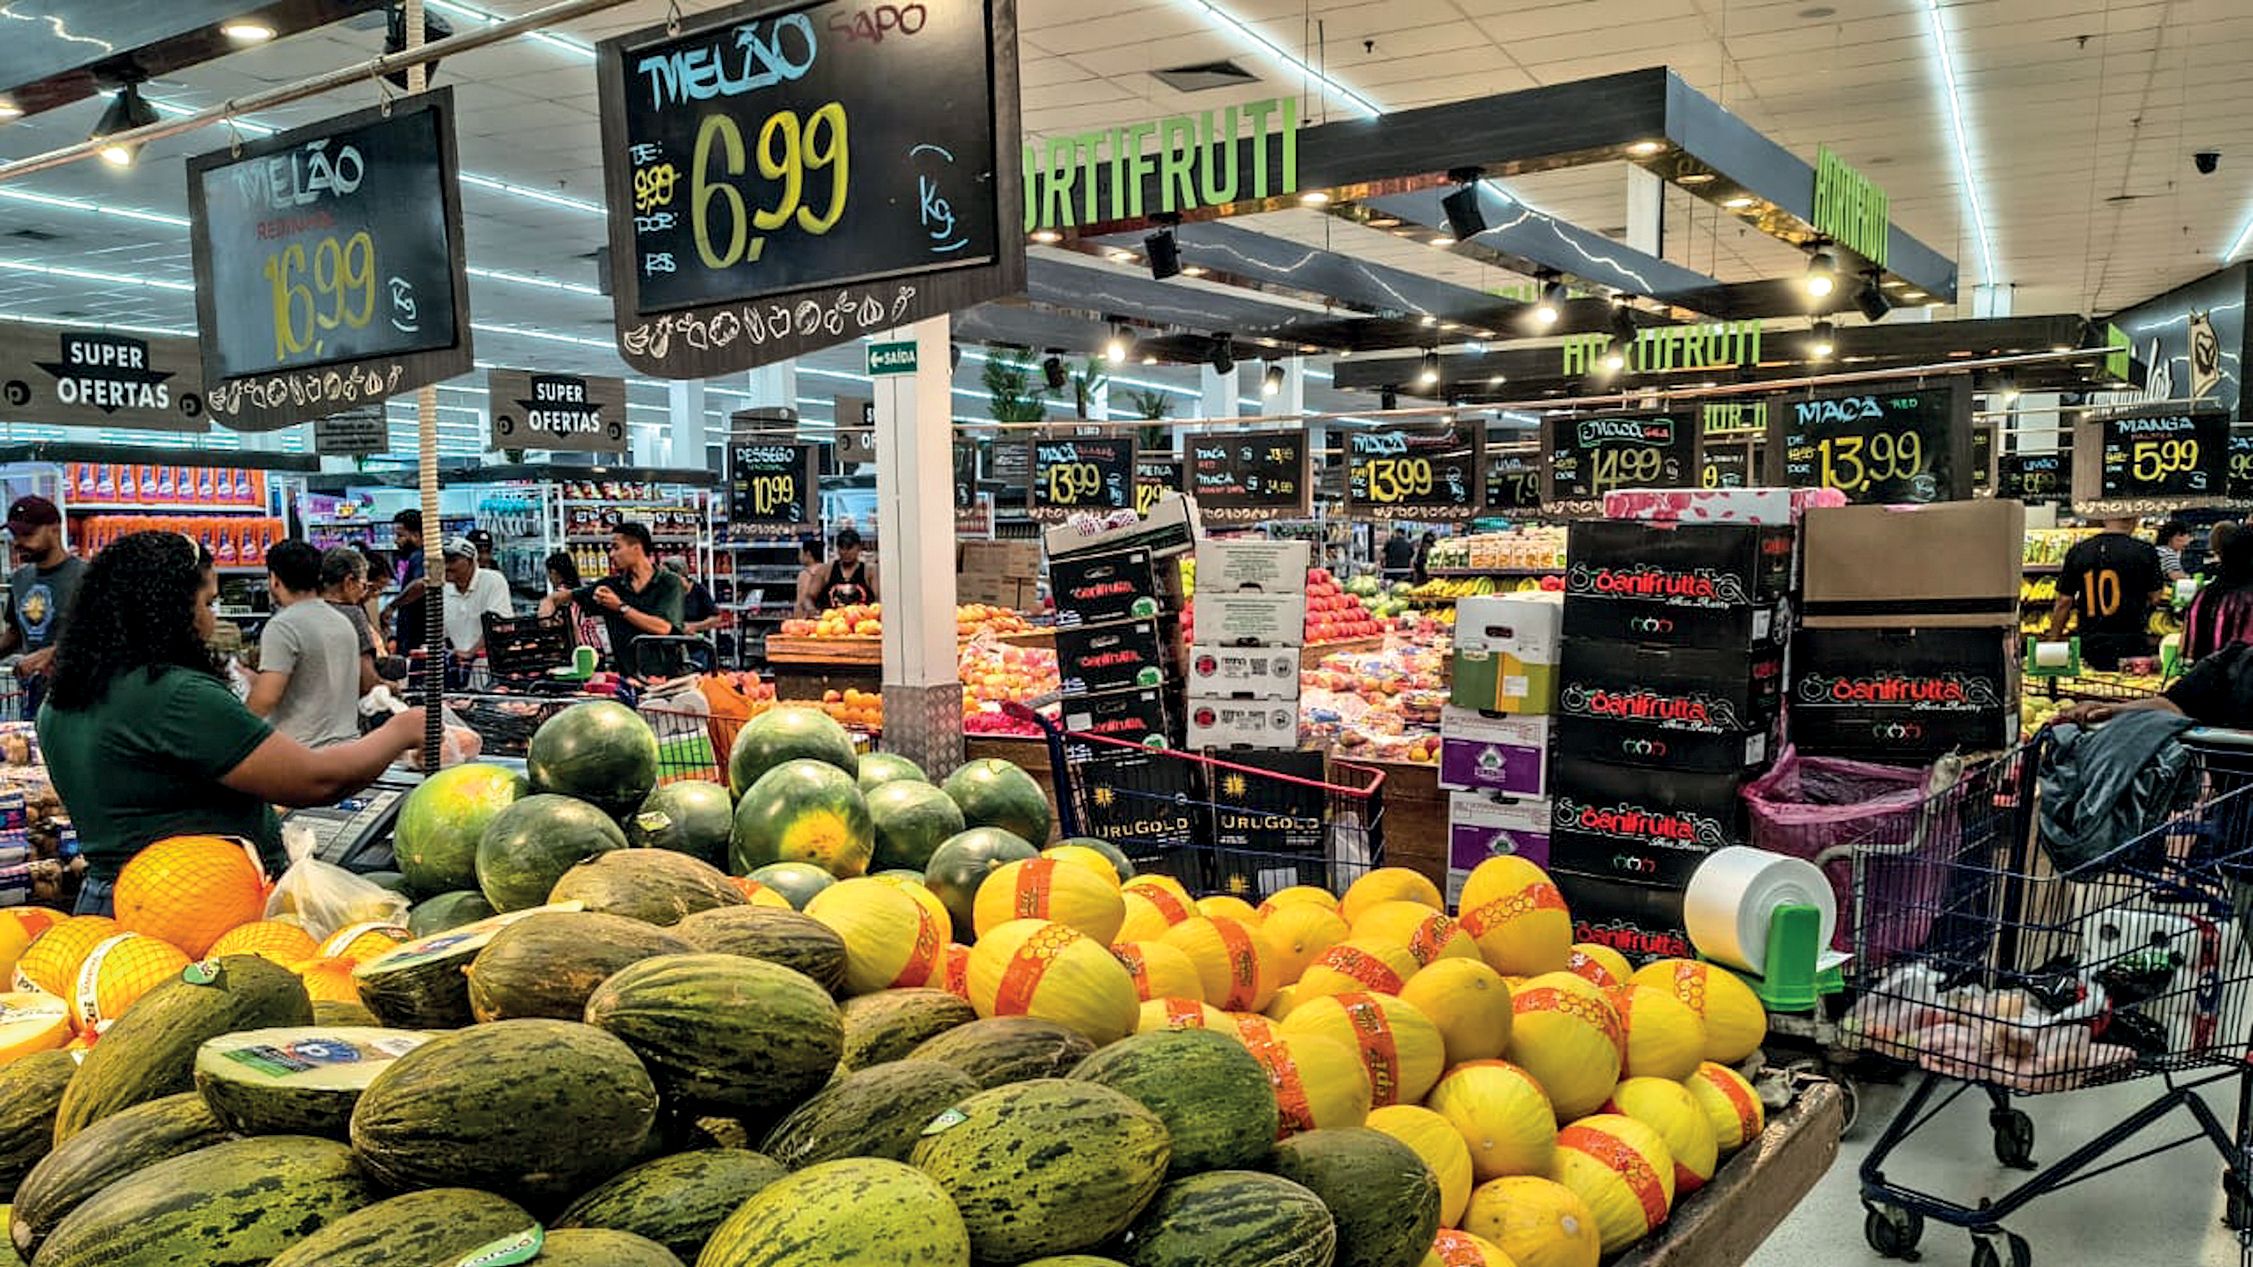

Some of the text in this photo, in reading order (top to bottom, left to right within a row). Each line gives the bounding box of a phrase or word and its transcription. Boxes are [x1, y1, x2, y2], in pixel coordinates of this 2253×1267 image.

[639, 4, 926, 111] MELÃO SAPO
[629, 140, 663, 166] DE:
[231, 138, 364, 209] MELÃO
[691, 101, 849, 270] 6,99
[264, 232, 376, 361] 16,99
[71, 341, 144, 370] SUPER
[884, 347, 915, 367] SAÍDA
[57, 377, 170, 409] OFERTAS
[536, 382, 583, 403] SUPER
[528, 410, 600, 433] OFERTAS
[2115, 416, 2195, 434] MANGA
[1818, 431, 1922, 492] 13,99
[2133, 440, 2198, 483] 5,99
[1049, 462, 1101, 505] 13,99
[1366, 458, 1432, 503] 13,99
[2083, 569, 2121, 618] 10
[1096, 817, 1188, 838] URUGOLD
[1221, 815, 1319, 831] URUGOLD
